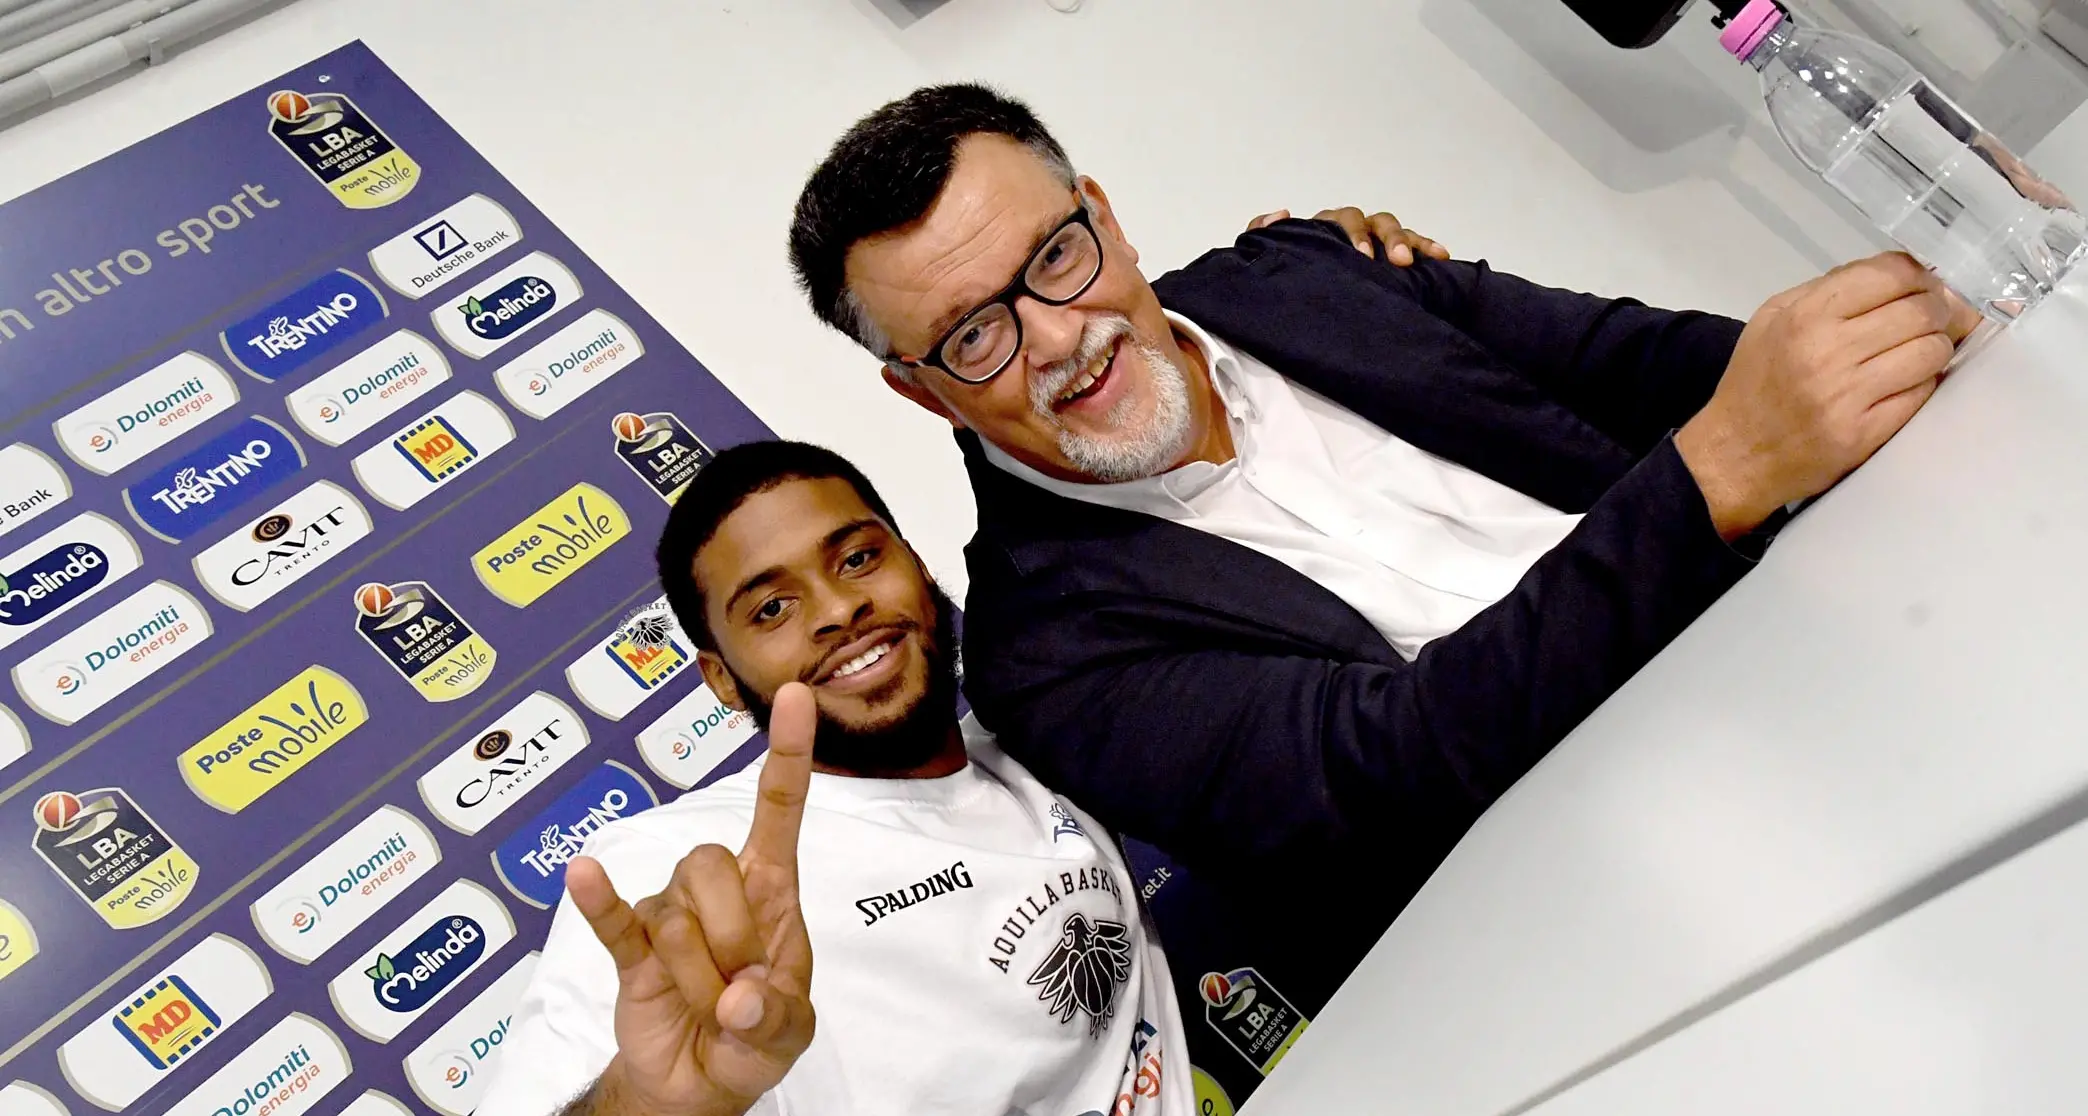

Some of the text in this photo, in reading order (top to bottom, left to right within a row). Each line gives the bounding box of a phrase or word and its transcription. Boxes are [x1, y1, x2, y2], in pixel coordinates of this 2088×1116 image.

[309, 126, 363, 158] LBA
[316, 135, 379, 171] LEGABASKET
[337, 149, 376, 173] SERIE A
[340, 158, 411, 196] Poste mobile
[0, 183, 281, 344] n altro sport
[411, 229, 510, 289] Deutsche Bank
[248, 292, 357, 360] TRENTINO
[549, 328, 617, 380] Dolomiti
[582, 341, 626, 375] energia
[342, 351, 420, 407] Dolomiti
[378, 366, 429, 401] energia
[116, 377, 205, 433] Dolomiti
[158, 391, 213, 428] energia
[413, 433, 454, 465] MD
[648, 442, 690, 473] LBA
[655, 448, 703, 485] LEGABASKET
[152, 440, 272, 515] TRENTINO
[671, 462, 702, 485] SERIE A
[3, 488, 53, 518] Bank
[231, 506, 344, 586] CAVIT
[486, 496, 613, 575] Poste mobile
[274, 539, 330, 576] TRENTO
[85, 605, 181, 672] Dolomiti
[129, 621, 190, 663] energia
[393, 615, 443, 651] LBA
[400, 622, 457, 665] LEGABASKET
[419, 638, 455, 664] SERIE A
[422, 643, 488, 687] Poste mobile
[196, 680, 347, 775] Poste mobile
[456, 718, 563, 809] CAVIT
[497, 755, 550, 796] TRENTO
[76, 827, 138, 870] LBA
[83, 834, 156, 886] LEGABASKET
[106, 852, 151, 885] SERIE A
[318, 831, 407, 907] Dolomiti
[107, 858, 189, 910] Poste mobile
[360, 850, 417, 897] energia
[855, 861, 974, 927] SPALDING
[989, 882, 1060, 974] AQUILA
[137, 999, 192, 1045] MD
[1238, 1002, 1275, 1040] LBA
[1248, 1007, 1288, 1054] LEGABASKET
[1263, 1024, 1288, 1052] SERIE A
[258, 1063, 321, 1116] energia
